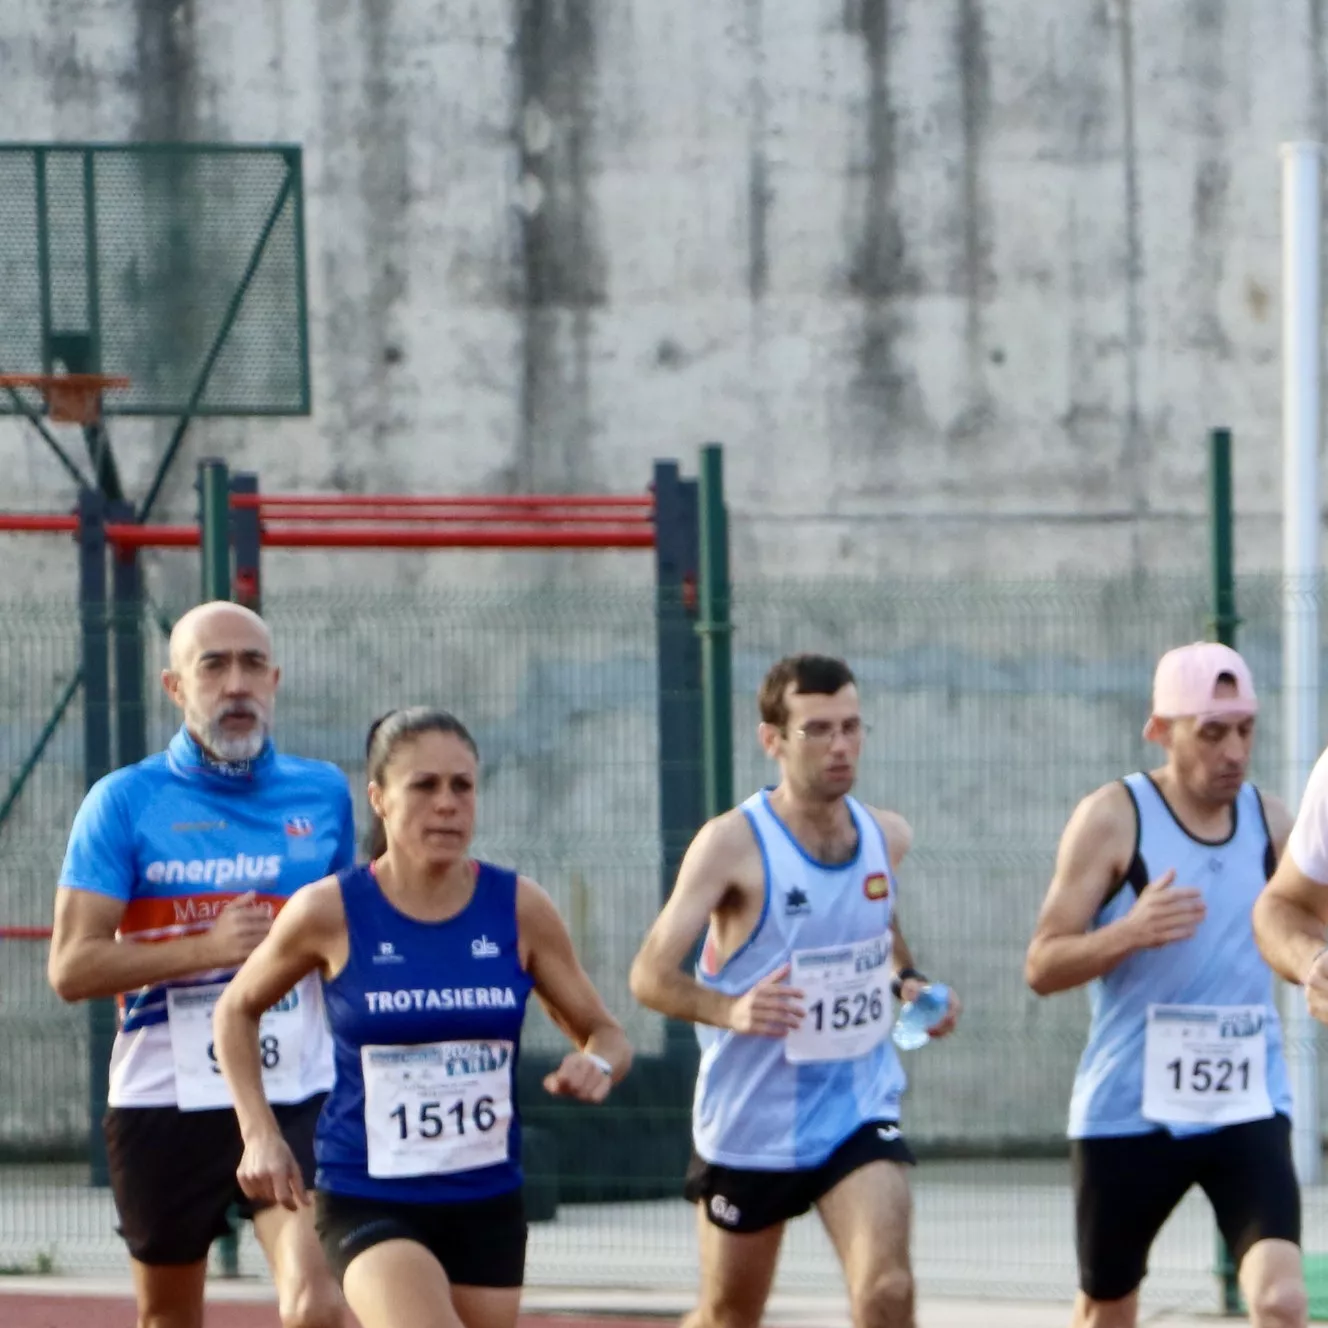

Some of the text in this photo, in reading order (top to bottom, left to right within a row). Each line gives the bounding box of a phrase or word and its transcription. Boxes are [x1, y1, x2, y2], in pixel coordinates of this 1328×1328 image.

[146, 852, 282, 886] enerplus
[365, 987, 516, 1014] TROTASIERRA
[809, 987, 884, 1031] 1526
[1166, 1057, 1251, 1093] 1521
[389, 1095, 497, 1140] 1516
